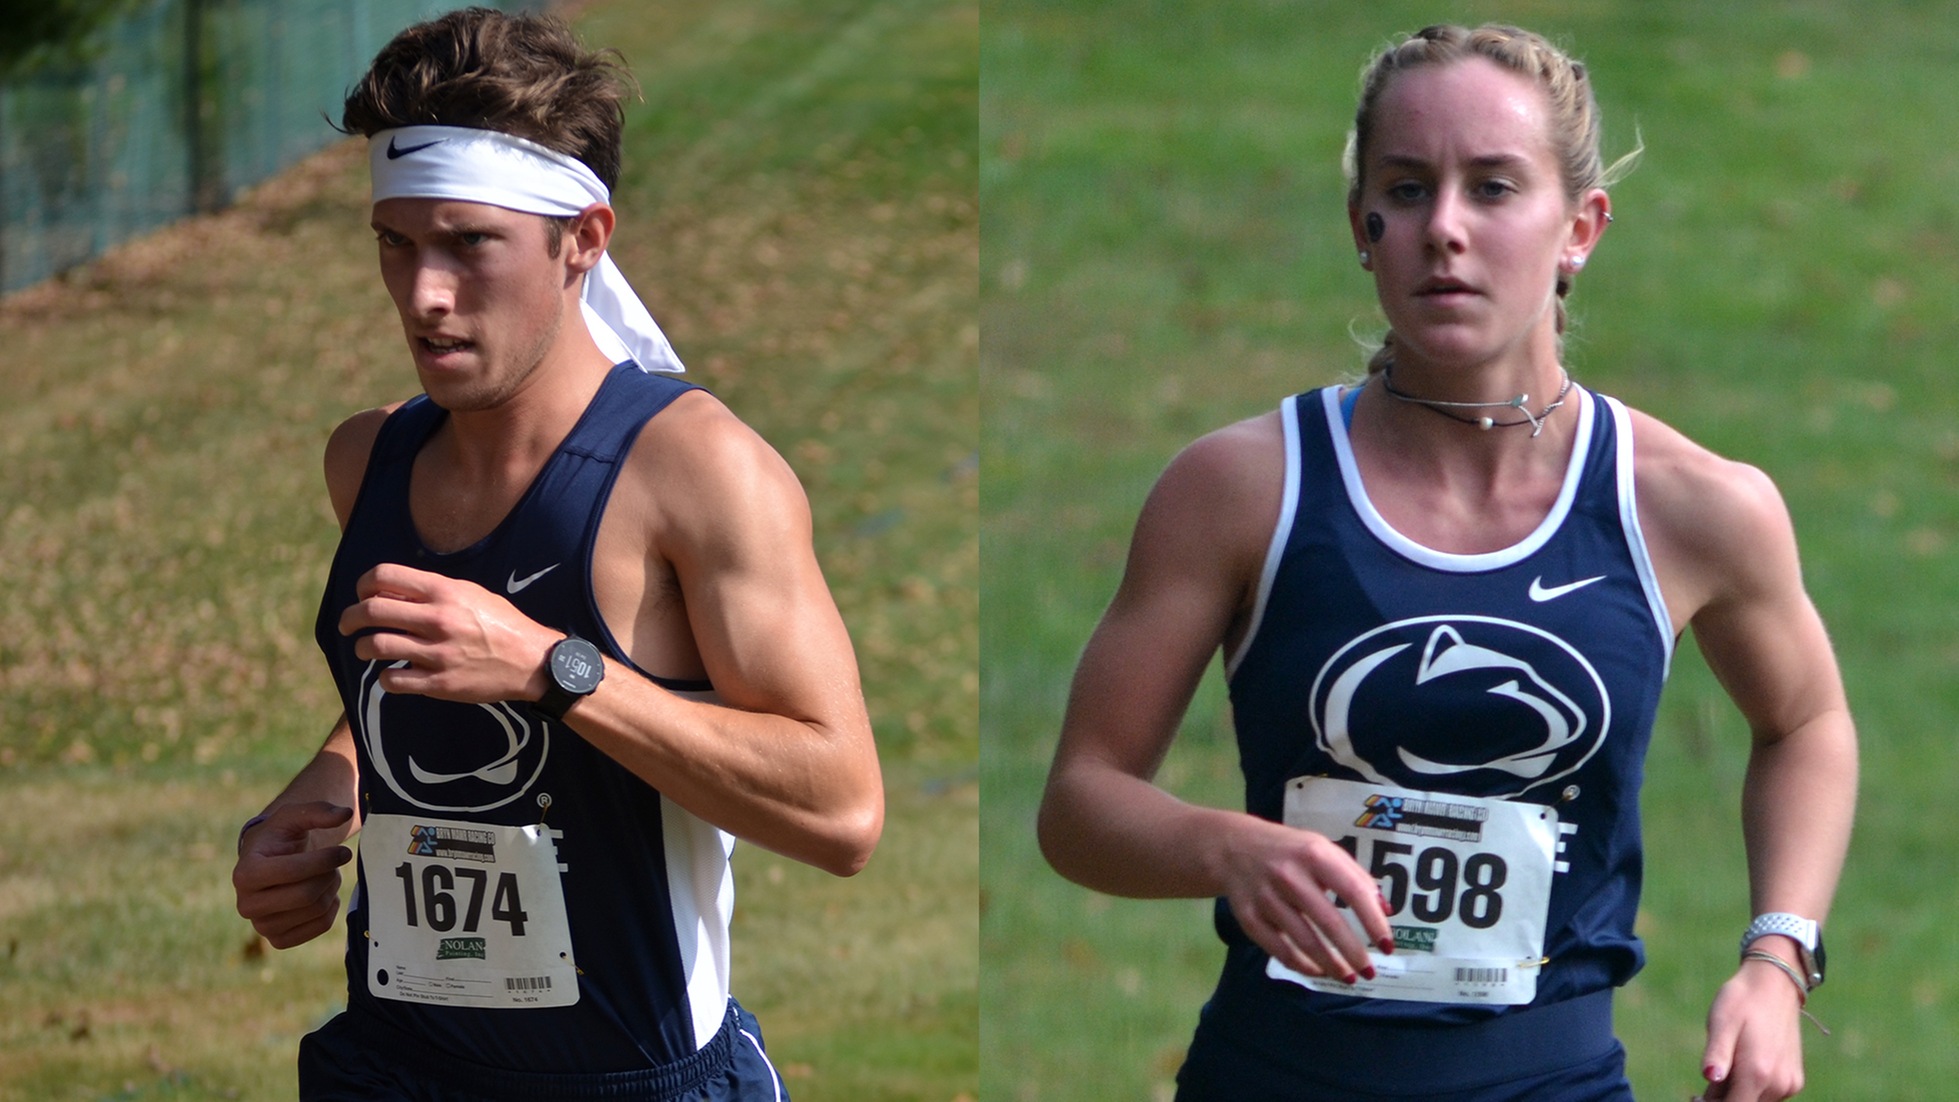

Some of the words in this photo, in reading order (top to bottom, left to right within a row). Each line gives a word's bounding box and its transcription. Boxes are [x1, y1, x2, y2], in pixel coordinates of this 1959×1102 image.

[395, 862, 528, 936] 1674
[1393, 928, 1435, 943] OLAN
[445, 940, 483, 951] NOLAN
